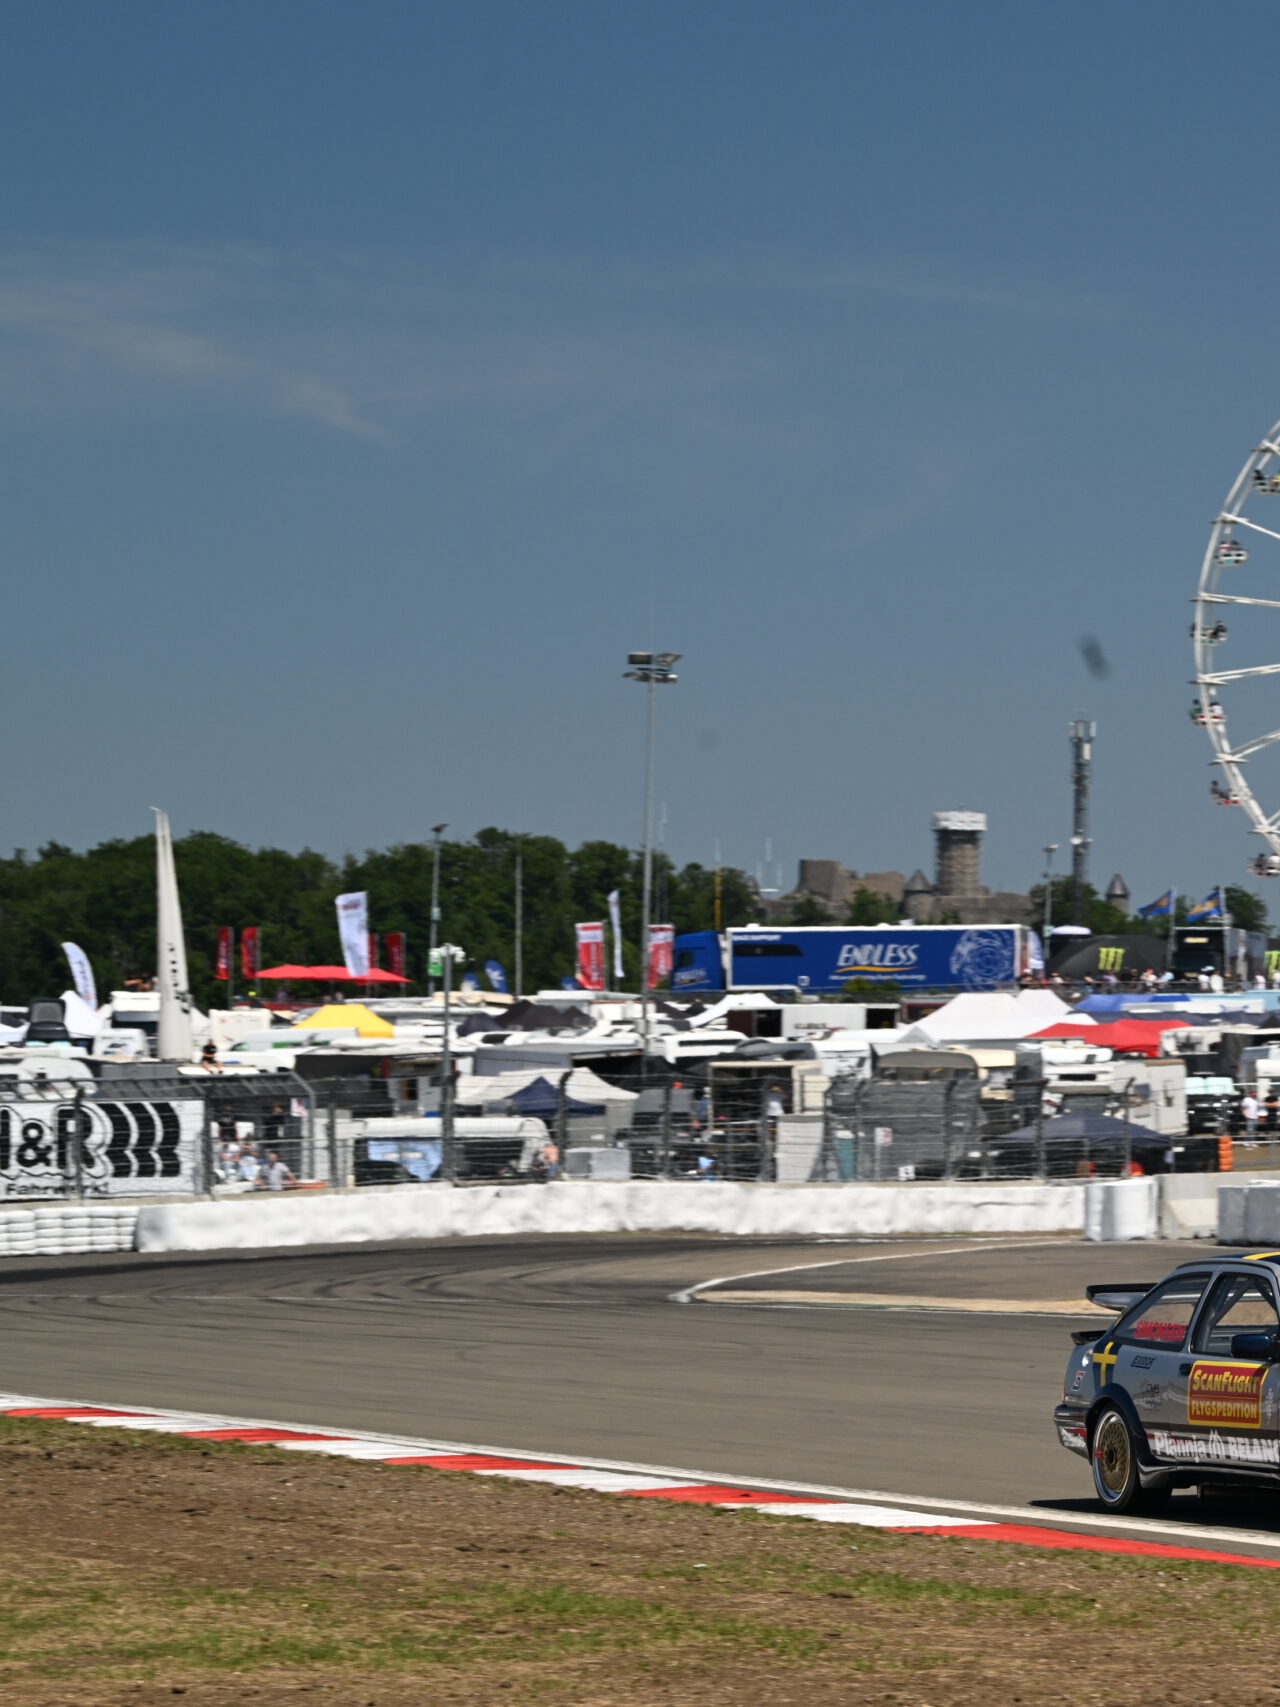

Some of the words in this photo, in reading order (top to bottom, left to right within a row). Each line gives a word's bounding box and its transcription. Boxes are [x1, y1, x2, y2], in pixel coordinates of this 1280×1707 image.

[837, 944, 920, 966] ENDLESS
[0, 1108, 95, 1170] &R
[1191, 1400, 1257, 1418] FLYGSPEDITION
[1154, 1432, 1207, 1463] Plannja
